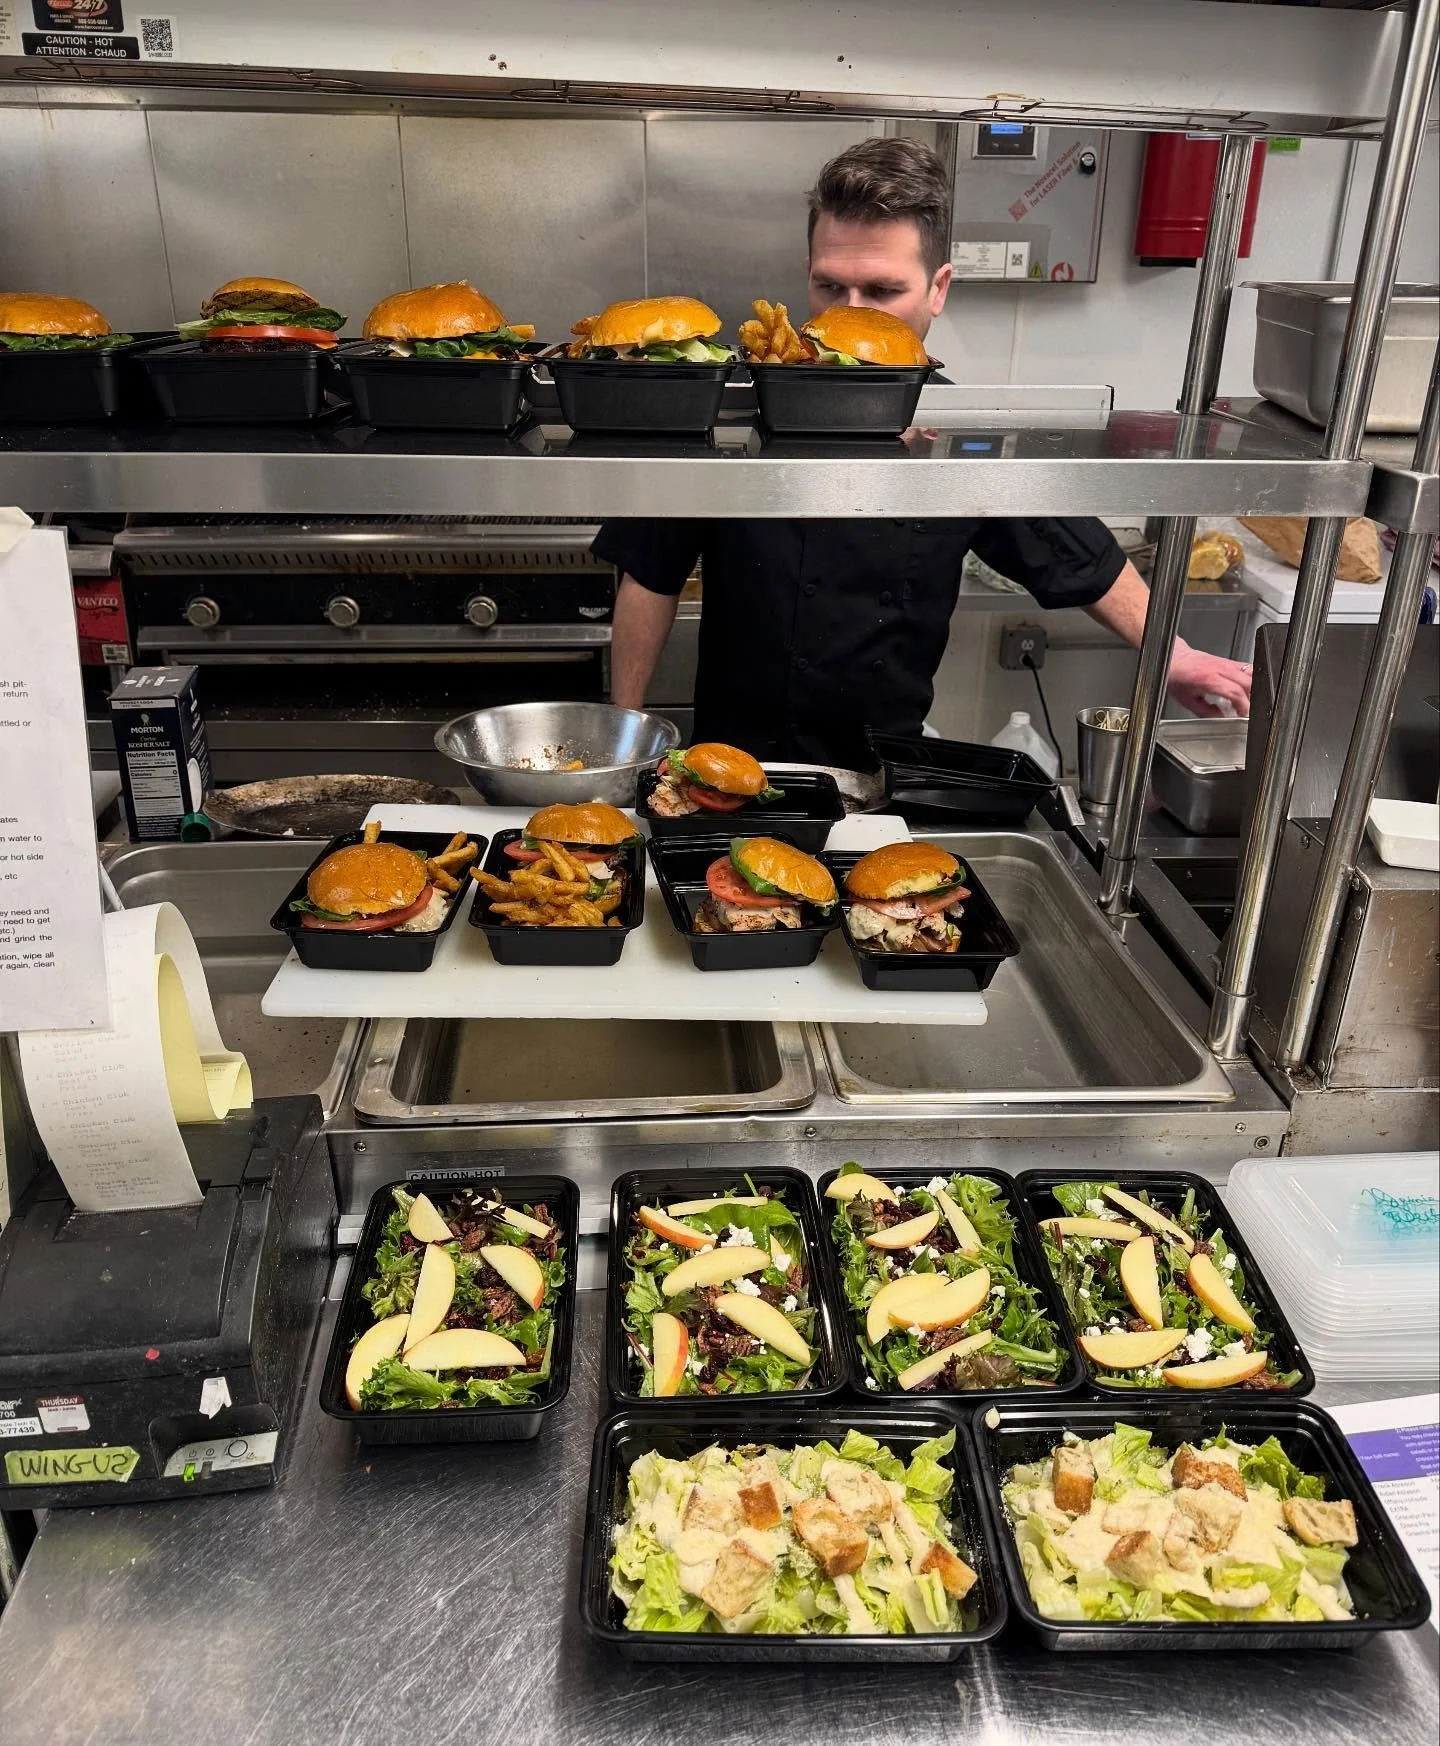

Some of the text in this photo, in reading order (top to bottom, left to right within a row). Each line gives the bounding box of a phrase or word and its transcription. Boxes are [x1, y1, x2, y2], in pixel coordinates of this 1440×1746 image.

[45, 35, 87, 45] CAUTION
[95, 38, 114, 46] HOT
[36, 47, 87, 56] ATTENTION
[95, 48, 127, 58] CHAUD
[13, 680, 28, 688] pit-
[131, 726, 164, 734] MORTON
[37, 917, 50, 925] get
[15, 935, 36, 943] grind
[23, 952, 42, 960] wipe
[6, 962, 31, 970] again,
[34, 960, 55, 968] clean
[41, 1398, 78, 1407] THURSDAY
